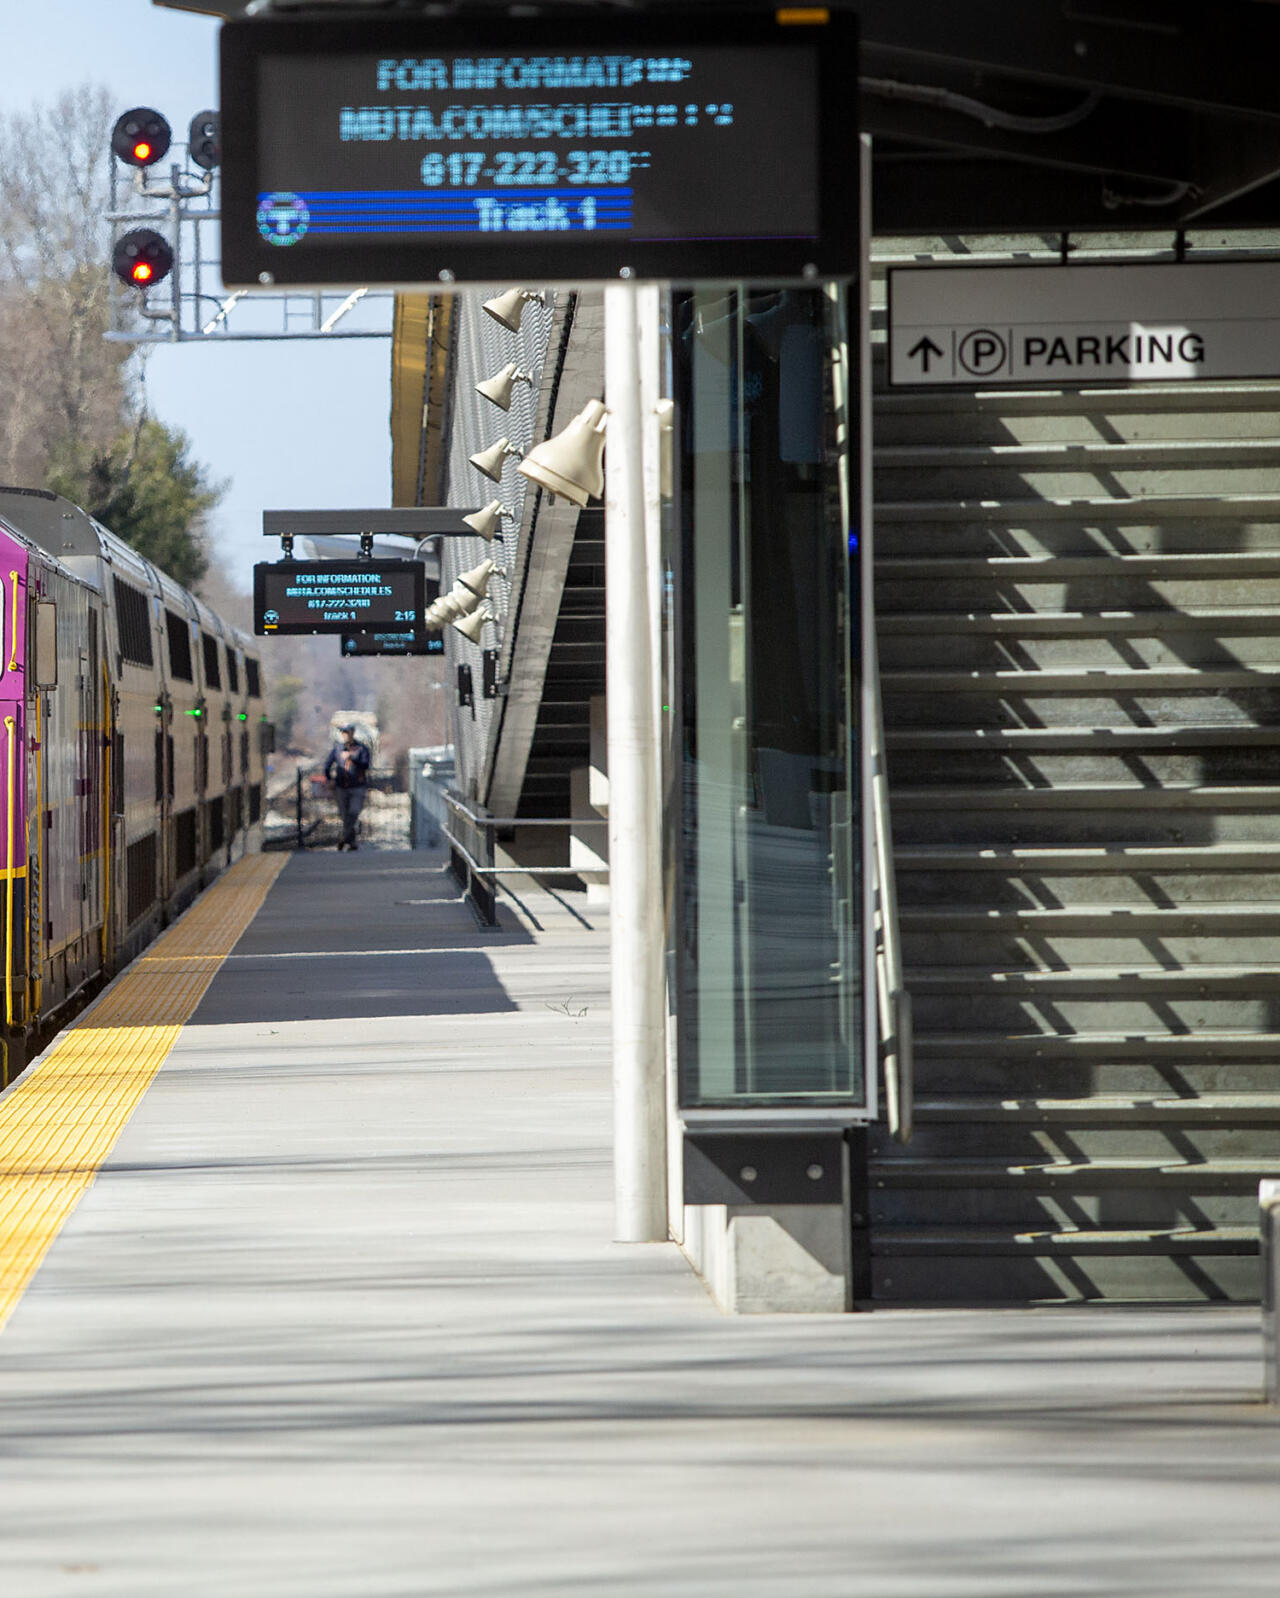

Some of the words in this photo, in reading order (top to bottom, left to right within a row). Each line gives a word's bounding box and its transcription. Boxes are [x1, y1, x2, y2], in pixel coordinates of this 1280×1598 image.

[376, 58, 448, 90] FOR
[472, 197, 571, 232] Track
[577, 196, 597, 231] 1
[1024, 332, 1206, 366] PARKING
[394, 610, 417, 621] 2:15
